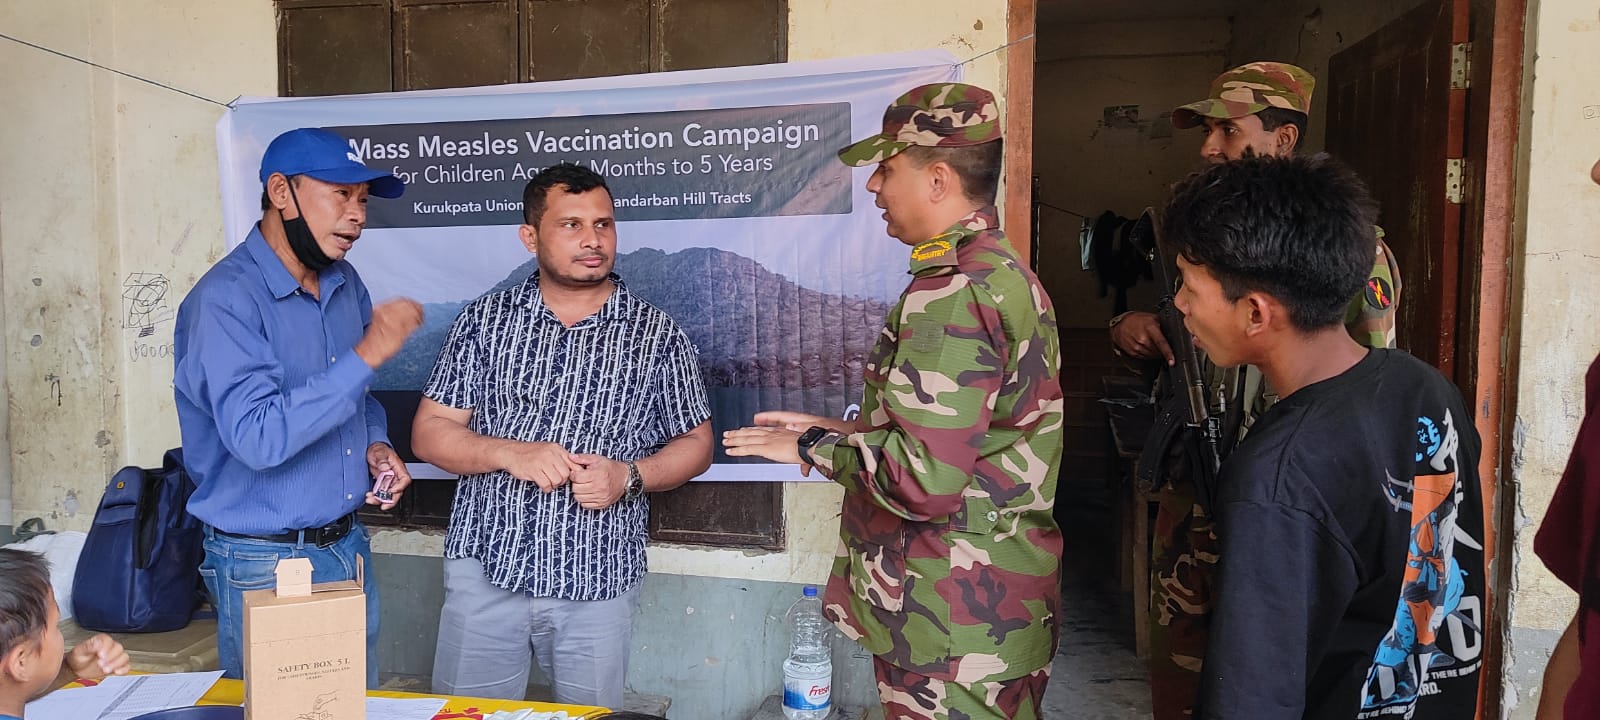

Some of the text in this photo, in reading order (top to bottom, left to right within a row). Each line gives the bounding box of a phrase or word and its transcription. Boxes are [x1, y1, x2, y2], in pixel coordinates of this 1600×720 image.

[348, 138, 410, 160] Mass
[418, 132, 518, 158] Measles
[525, 126, 673, 154] Vaccination
[683, 120, 819, 150] Campaign
[424, 163, 505, 184] Children
[590, 157, 666, 177] Months
[672, 158, 693, 175] to
[700, 155, 712, 173] 5
[719, 154, 773, 173] Years
[413, 191, 752, 216] Kurukpata Union andarban Hill Tracts
[278, 663, 310, 673] SAFETY
[313, 660, 333, 669] BOX
[337, 658, 343, 666] 5
